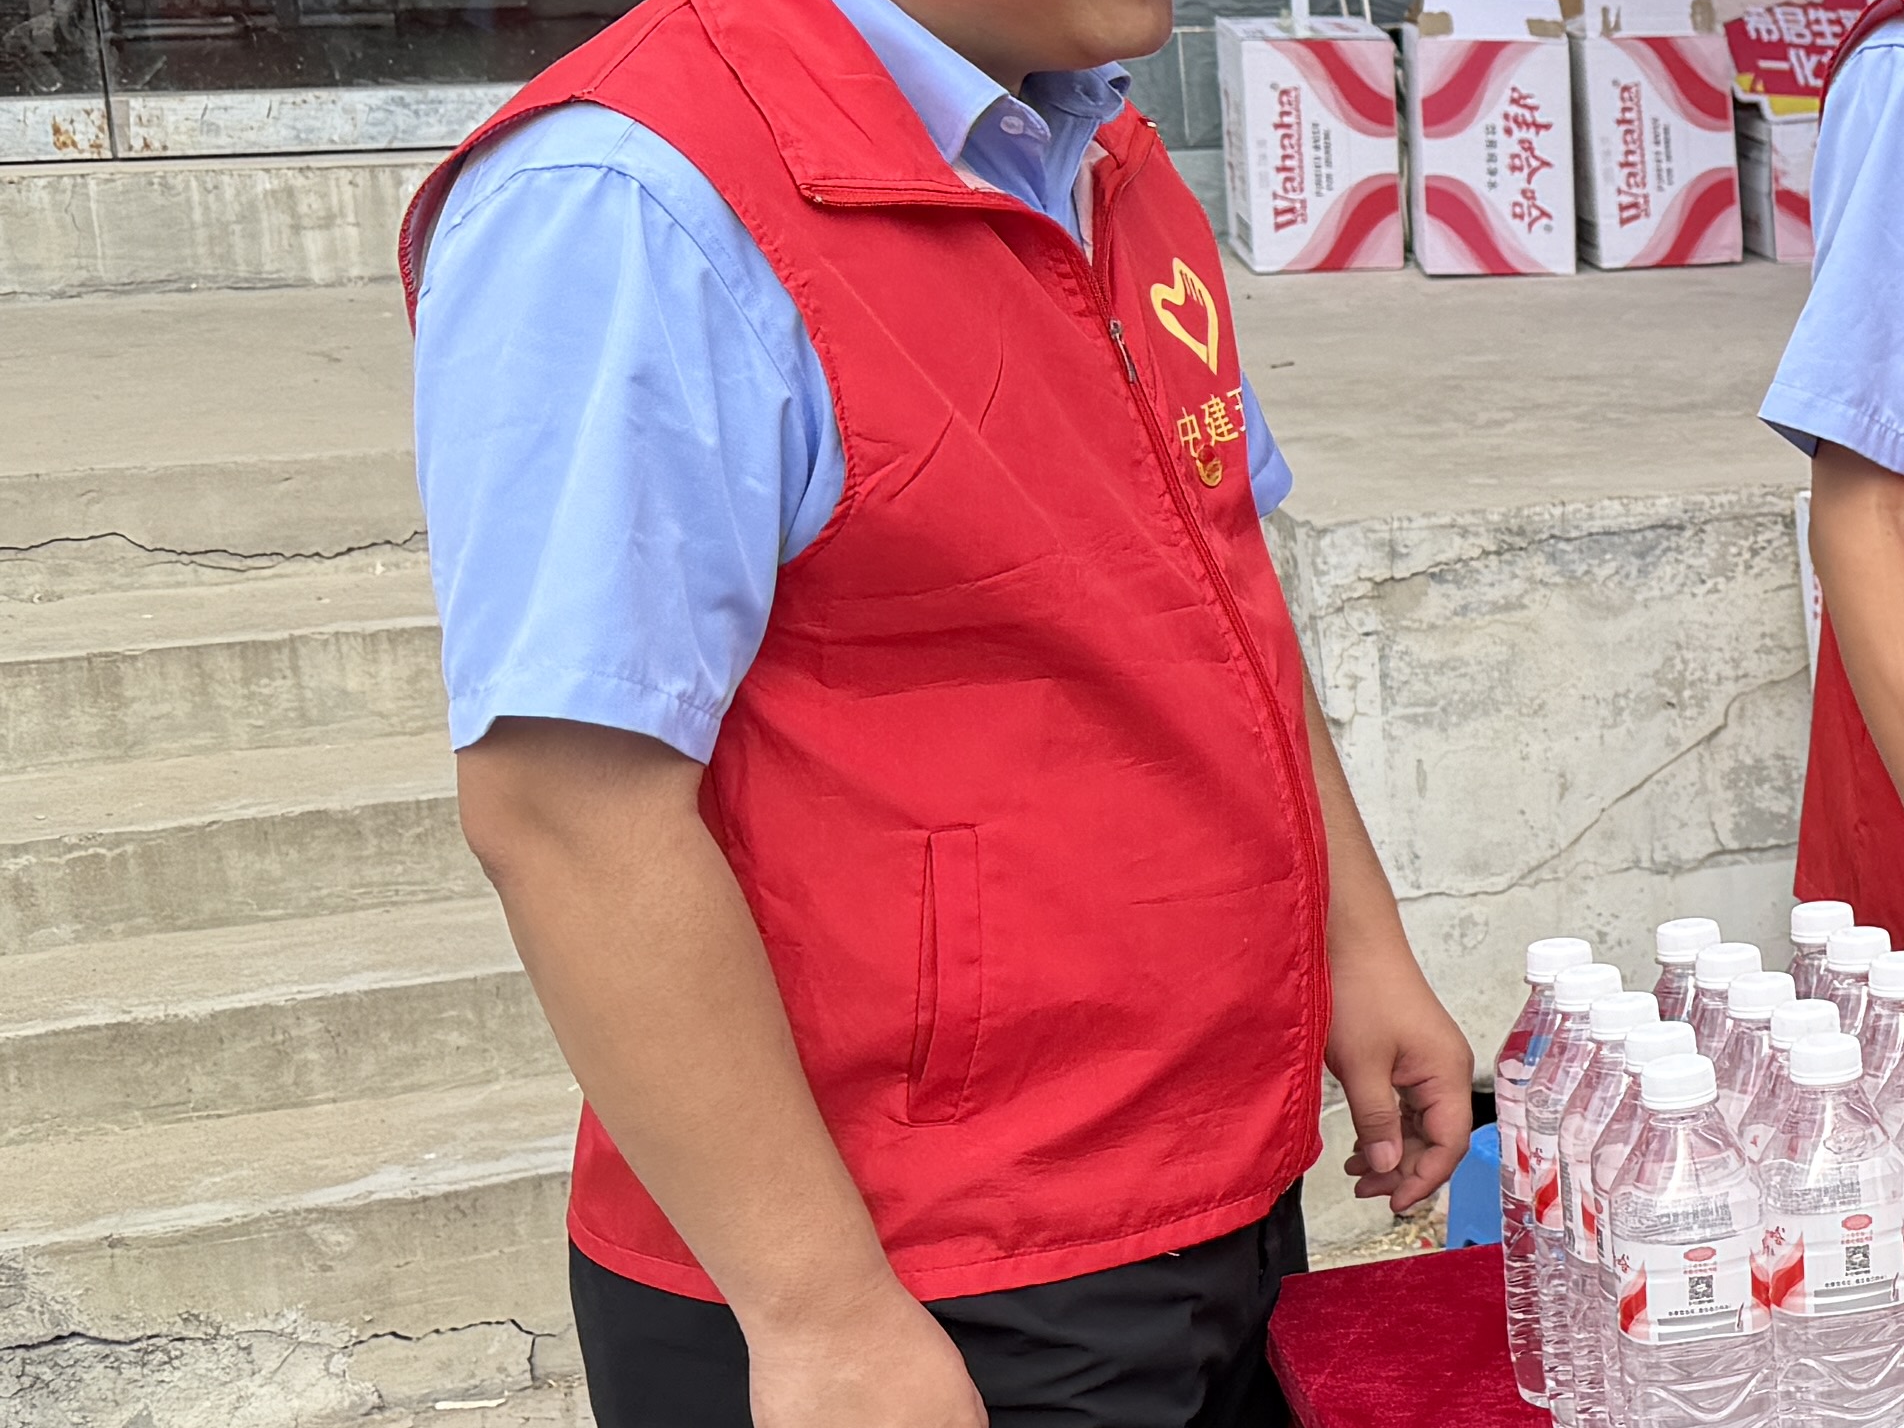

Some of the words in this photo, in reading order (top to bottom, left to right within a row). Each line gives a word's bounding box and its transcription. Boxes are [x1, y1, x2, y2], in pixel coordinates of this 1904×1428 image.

[1272, 86, 1307, 233] Wahaha
[1503, 86, 1554, 233] 娃哈哈
[1616, 81, 1650, 228] Wahaha
